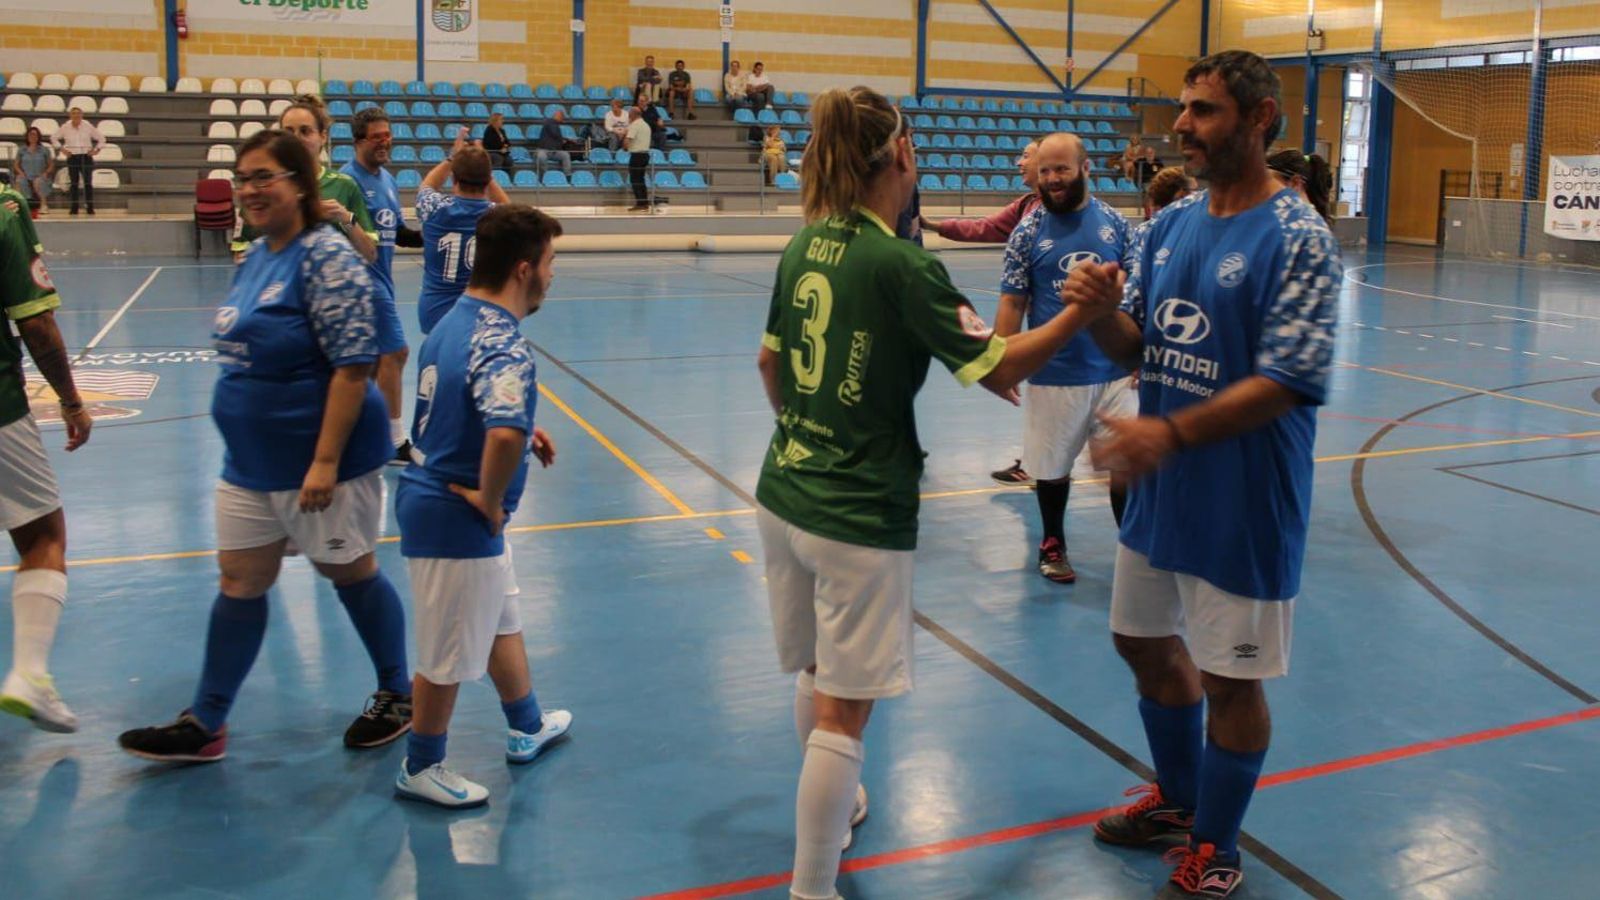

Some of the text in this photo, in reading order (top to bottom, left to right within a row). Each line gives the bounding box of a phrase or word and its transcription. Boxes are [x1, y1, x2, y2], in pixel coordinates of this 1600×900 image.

[1554, 164, 1600, 177] Lucha
[1554, 191, 1600, 210] CÁN
[806, 236, 846, 266] GUTI
[790, 271, 833, 395] 3
[838, 330, 868, 406] RUTESA
[1176, 377, 1215, 399] Motor
